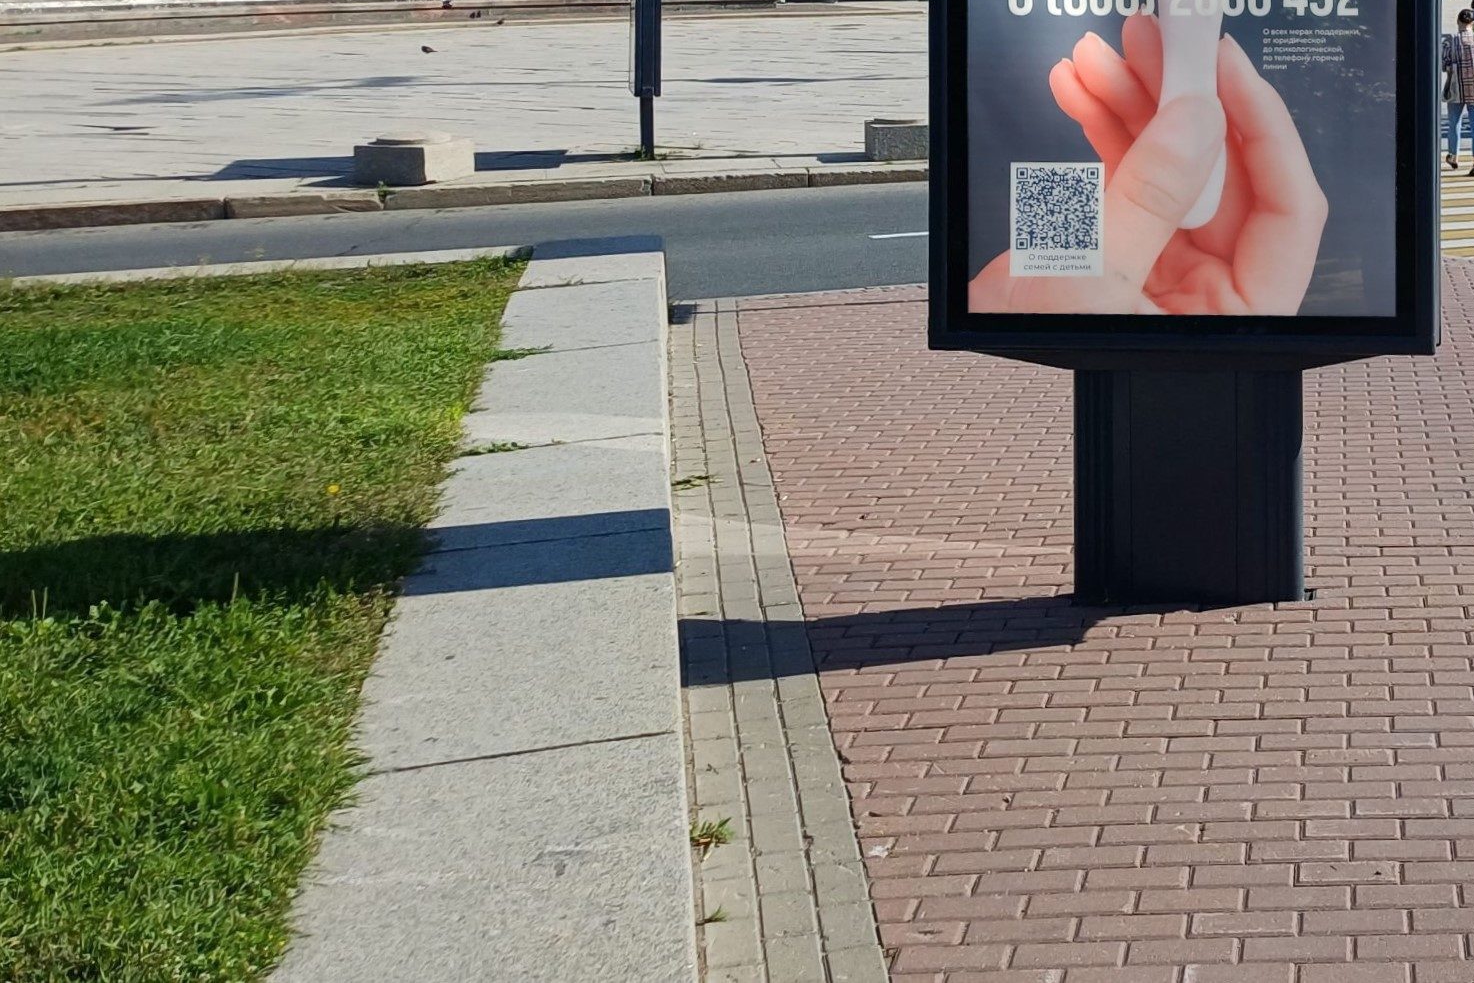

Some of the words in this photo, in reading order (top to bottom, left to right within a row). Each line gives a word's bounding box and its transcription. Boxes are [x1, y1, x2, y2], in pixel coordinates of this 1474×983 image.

[1028, 253, 1036, 261] О
[1037, 254, 1088, 262] поддержке
[1023, 263, 1051, 271] семей
